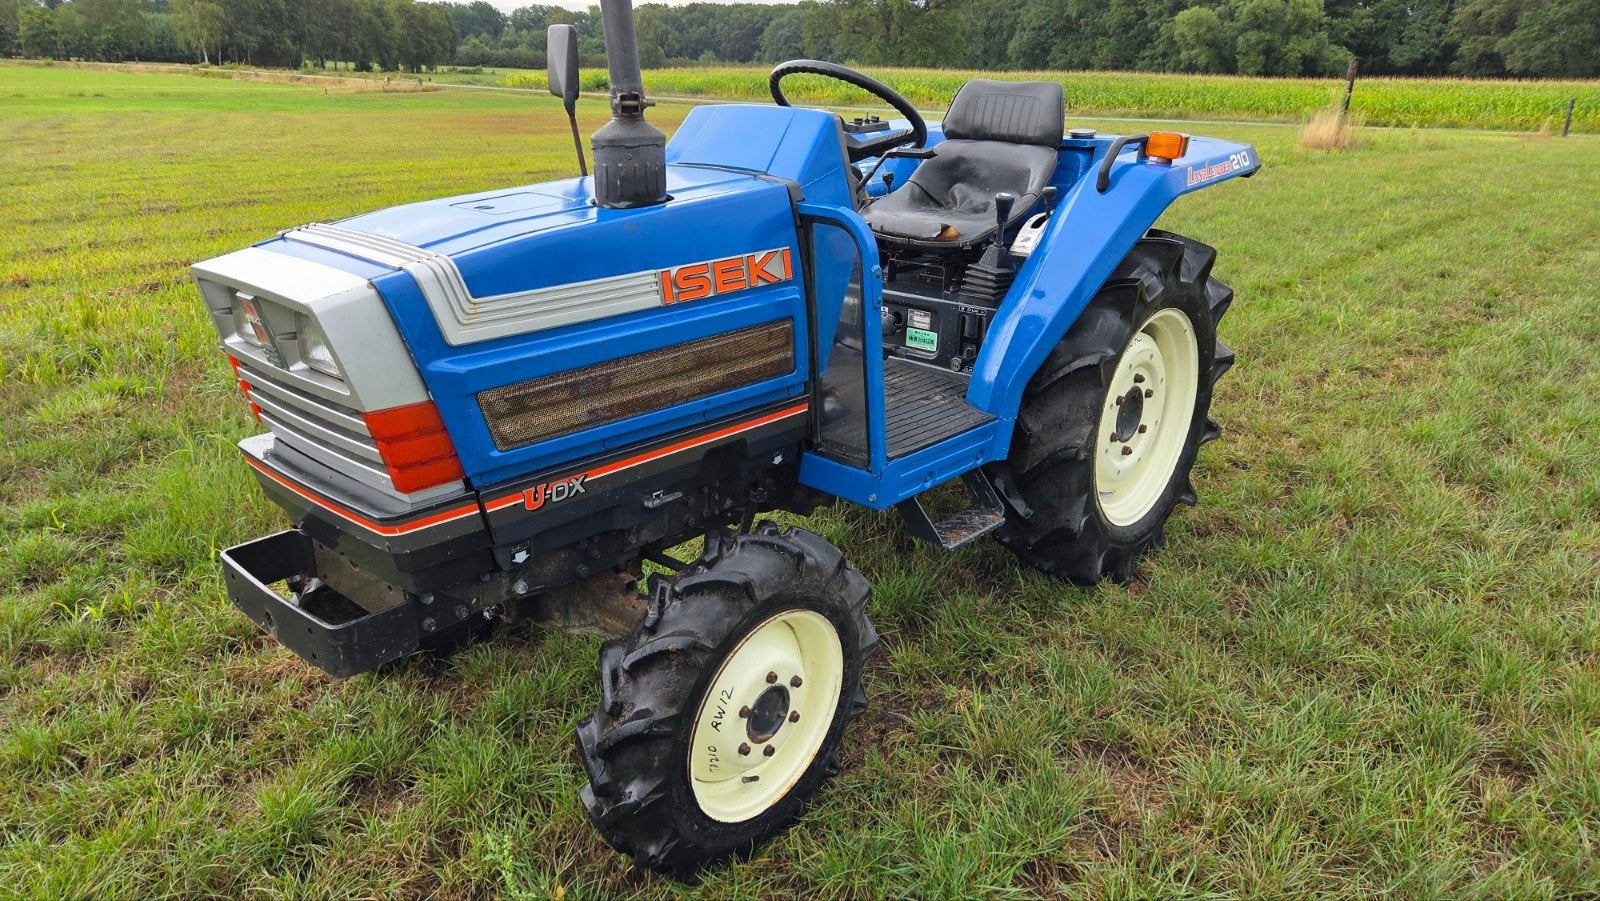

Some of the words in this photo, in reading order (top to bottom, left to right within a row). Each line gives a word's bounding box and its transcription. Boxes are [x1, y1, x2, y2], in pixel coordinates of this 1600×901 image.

[1229, 151, 1250, 170] 210
[660, 247, 793, 305] ISEKI
[521, 474, 588, 511] U-DX
[711, 686, 735, 732] RW12
